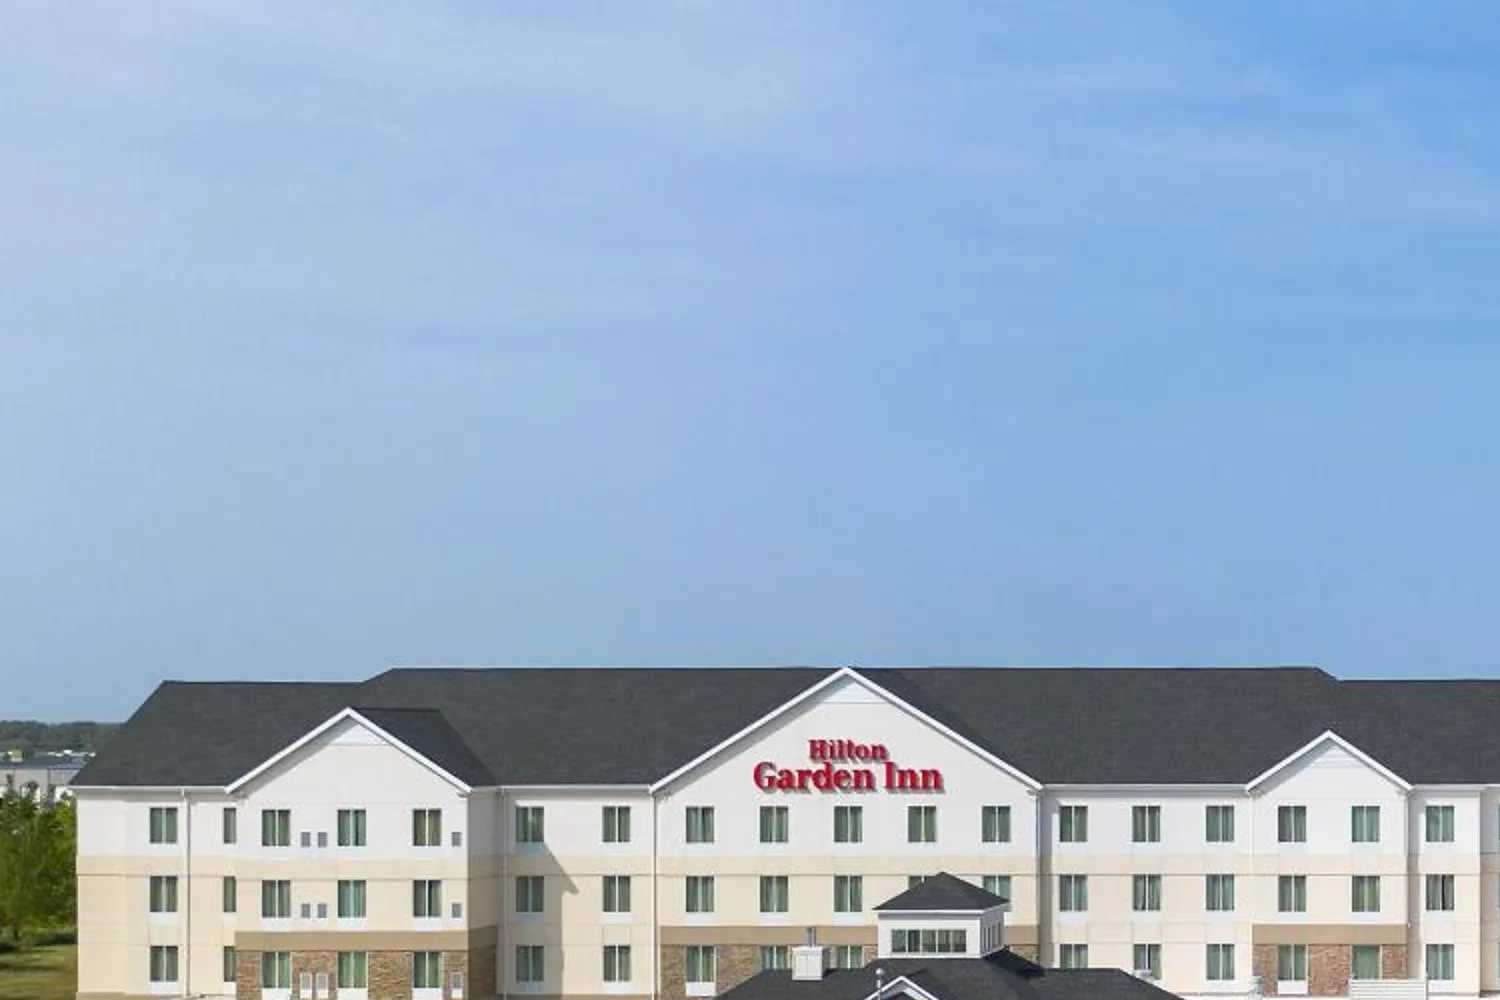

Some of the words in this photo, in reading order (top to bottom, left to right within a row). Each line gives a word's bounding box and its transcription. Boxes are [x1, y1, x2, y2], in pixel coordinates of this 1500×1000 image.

[808, 739, 888, 760] Hilton
[753, 761, 875, 791] Garden
[883, 761, 943, 791] Inn
